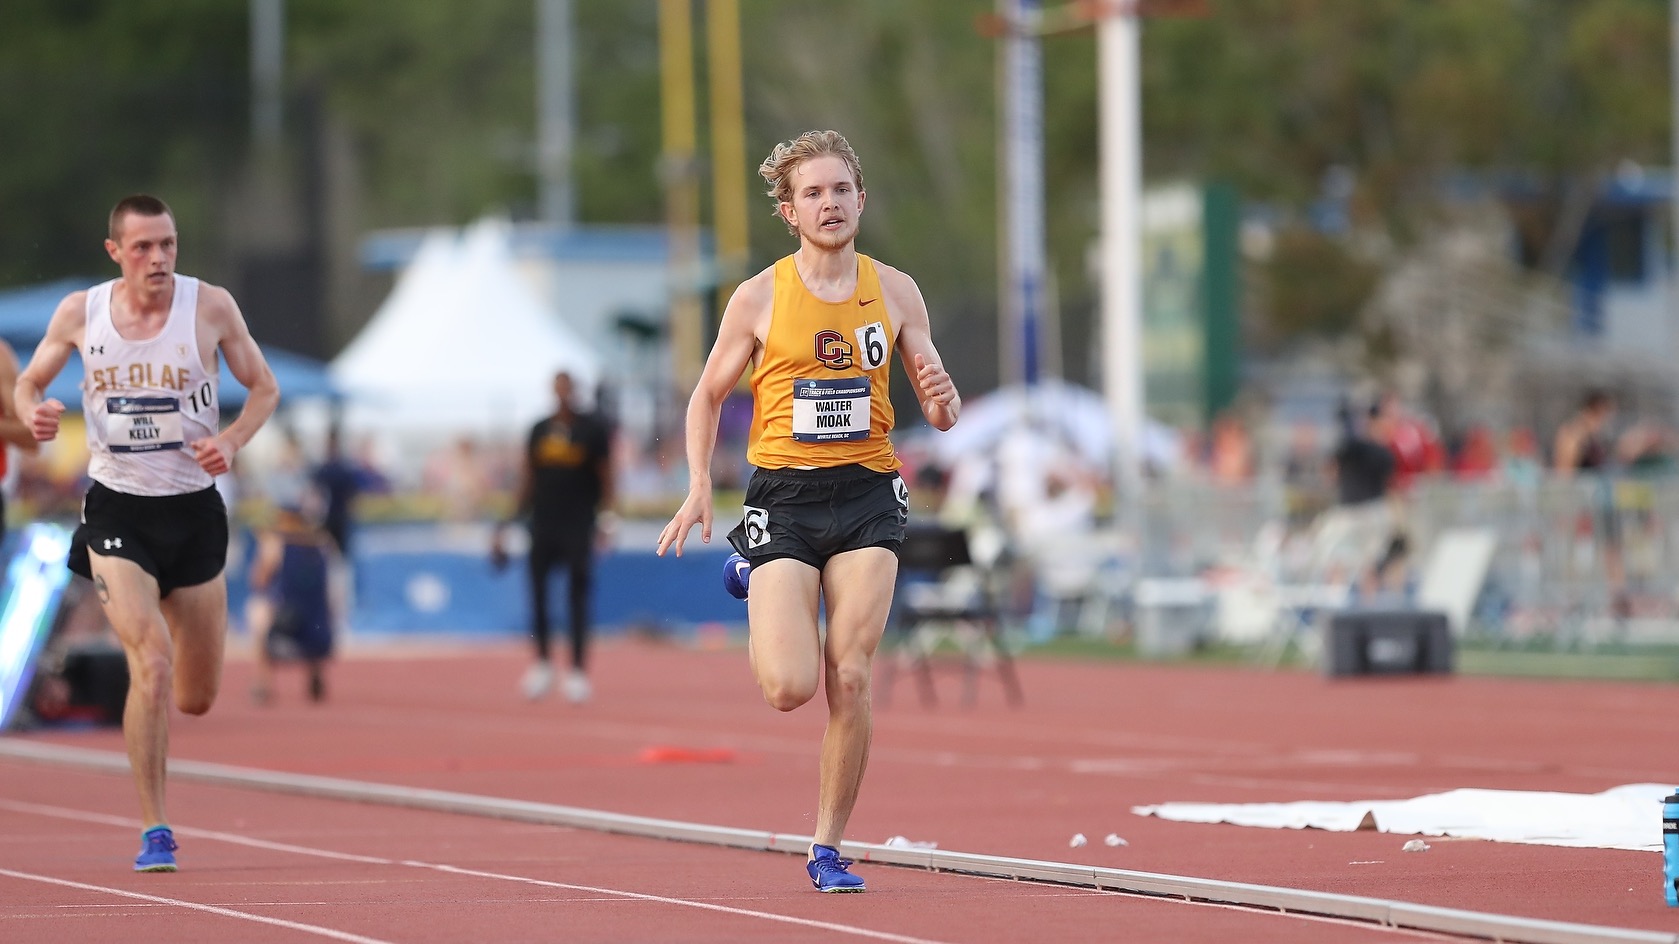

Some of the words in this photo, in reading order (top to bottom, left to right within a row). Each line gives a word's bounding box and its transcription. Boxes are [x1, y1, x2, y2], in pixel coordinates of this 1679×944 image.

[865, 326, 883, 367] 6
[93, 366, 125, 391] ST.
[128, 363, 190, 390] OLAF
[188, 382, 212, 413] 10
[815, 400, 852, 412] WALTER
[132, 417, 154, 425] WILL
[816, 414, 852, 428] MOAK
[129, 428, 160, 440] KELLY
[746, 510, 763, 545] 6
